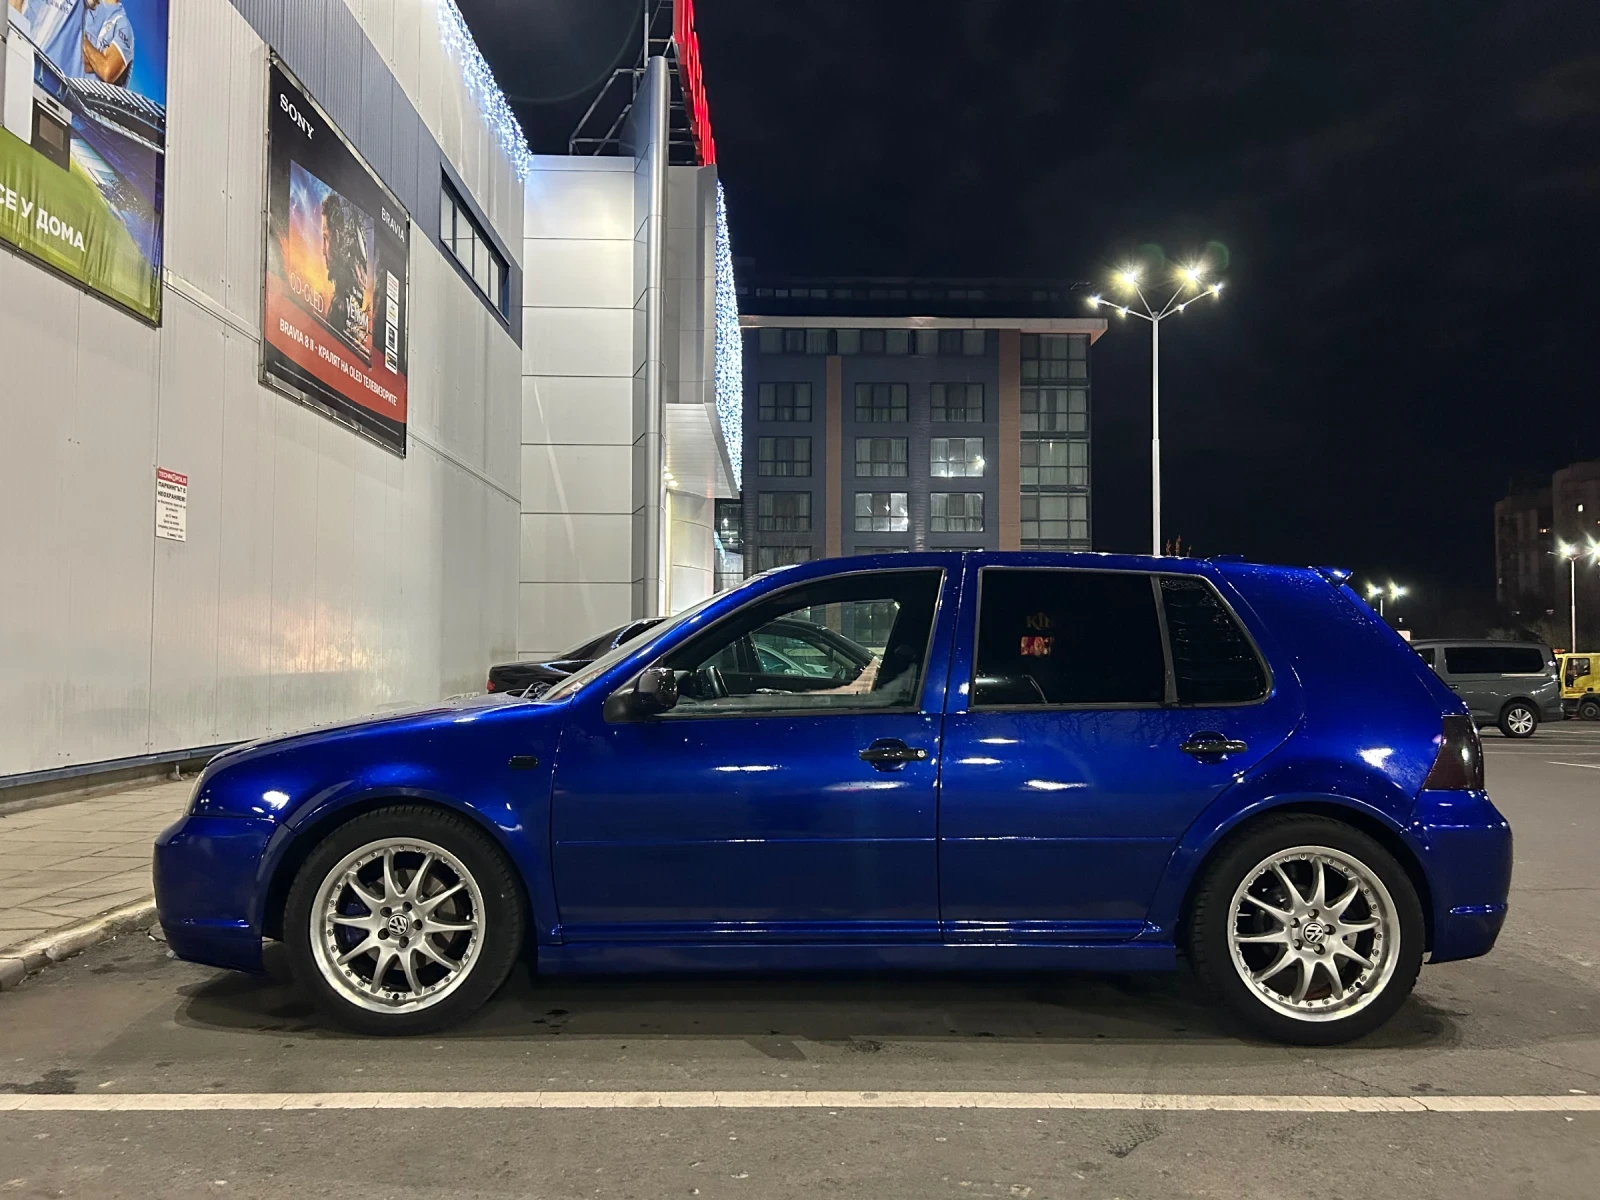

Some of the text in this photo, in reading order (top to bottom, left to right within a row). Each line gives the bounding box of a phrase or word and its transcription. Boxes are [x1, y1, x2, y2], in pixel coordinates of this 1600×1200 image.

[280, 93, 315, 140] SONY
[21, 196, 33, 218] У
[36, 207, 86, 253] ДОМА
[381, 206, 405, 243] BRAVIA
[290, 272, 324, 313] QD-OLED
[279, 317, 304, 345] BRAVIA
[304, 335, 309, 348] 8
[318, 344, 340, 369] КРАЛЯТ
[341, 359, 349, 375] НА
[349, 365, 362, 384] OLED
[363, 374, 398, 406] ТЕЛЕВИЗОРИТЕ
[389, 914, 408, 936] VW
[1304, 922, 1323, 944] VW
